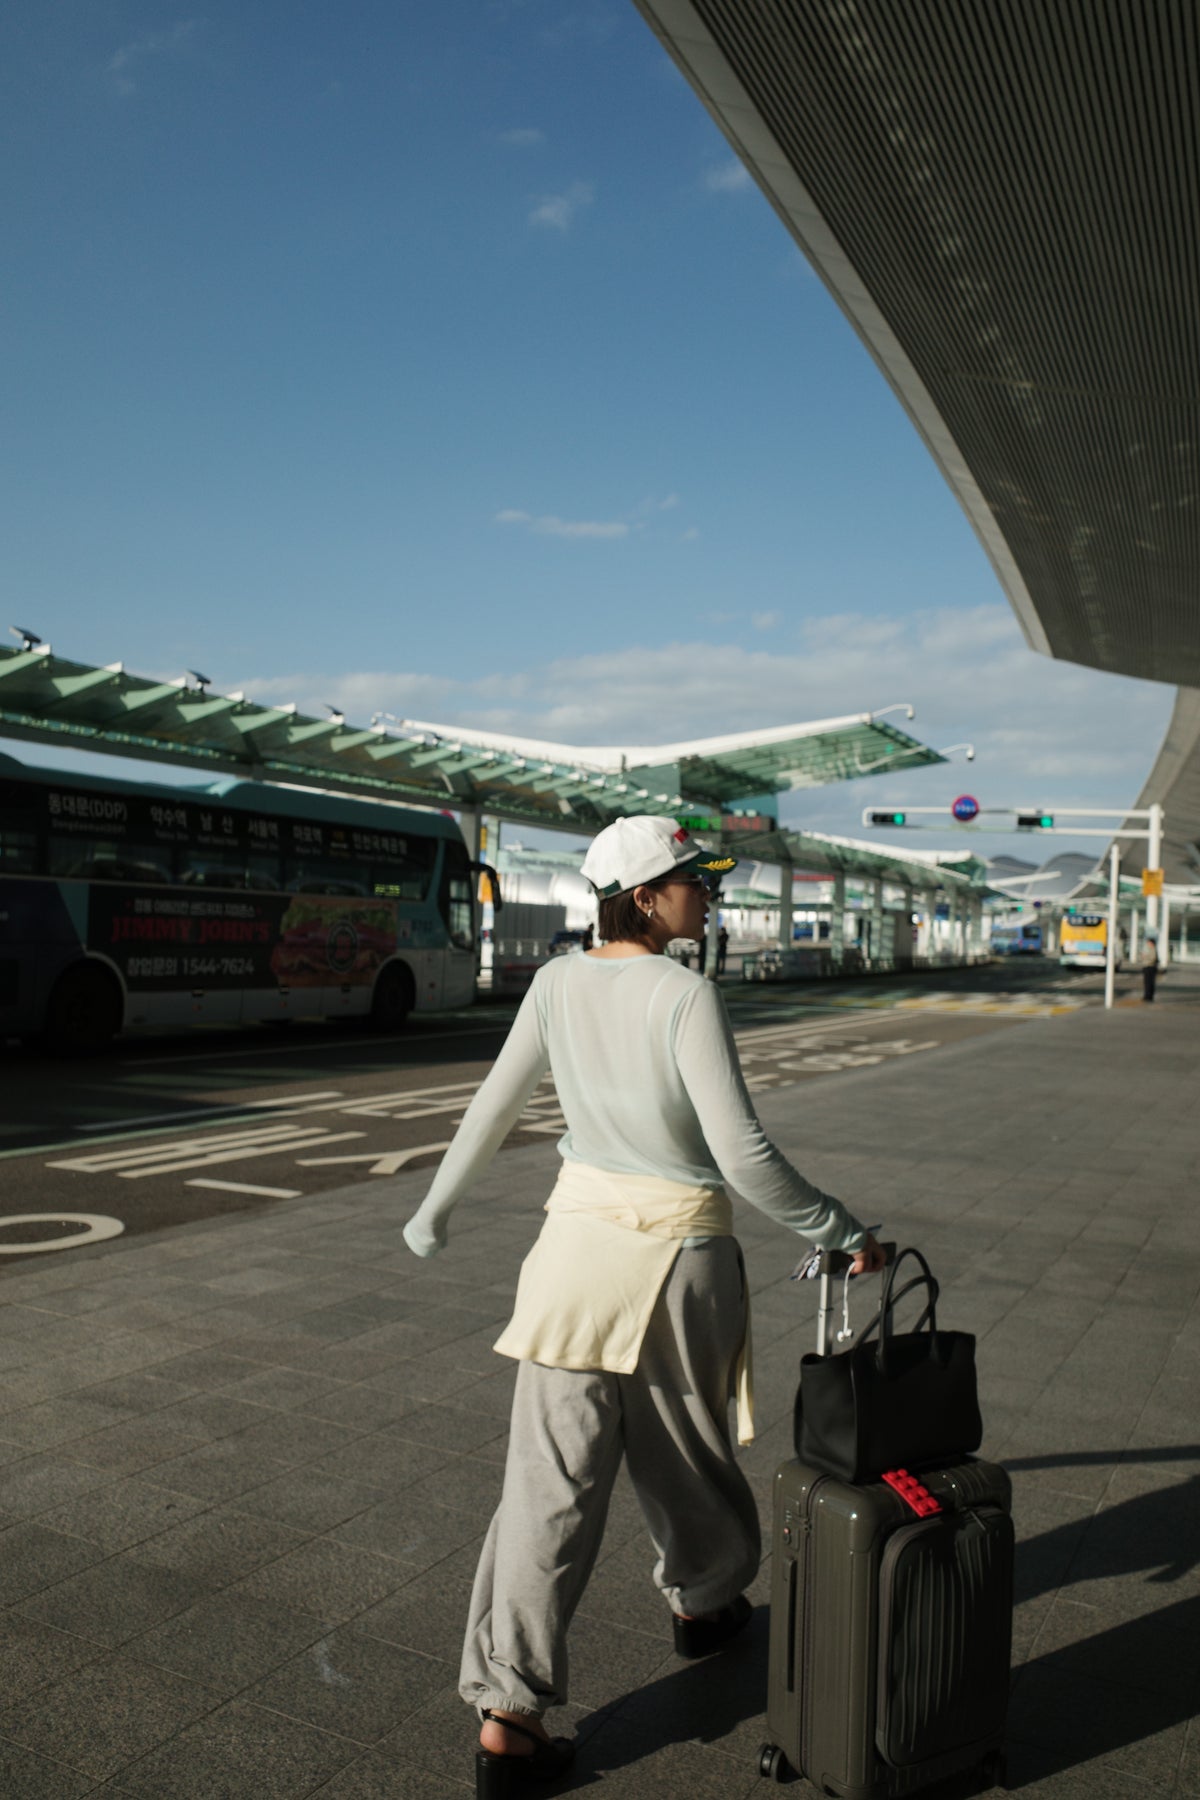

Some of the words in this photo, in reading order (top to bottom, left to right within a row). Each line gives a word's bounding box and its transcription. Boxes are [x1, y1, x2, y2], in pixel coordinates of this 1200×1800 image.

[47, 792, 128, 822] 동대문(DDP)
[111, 916, 192, 944] JIMMY
[198, 918, 273, 945] JOHN'S
